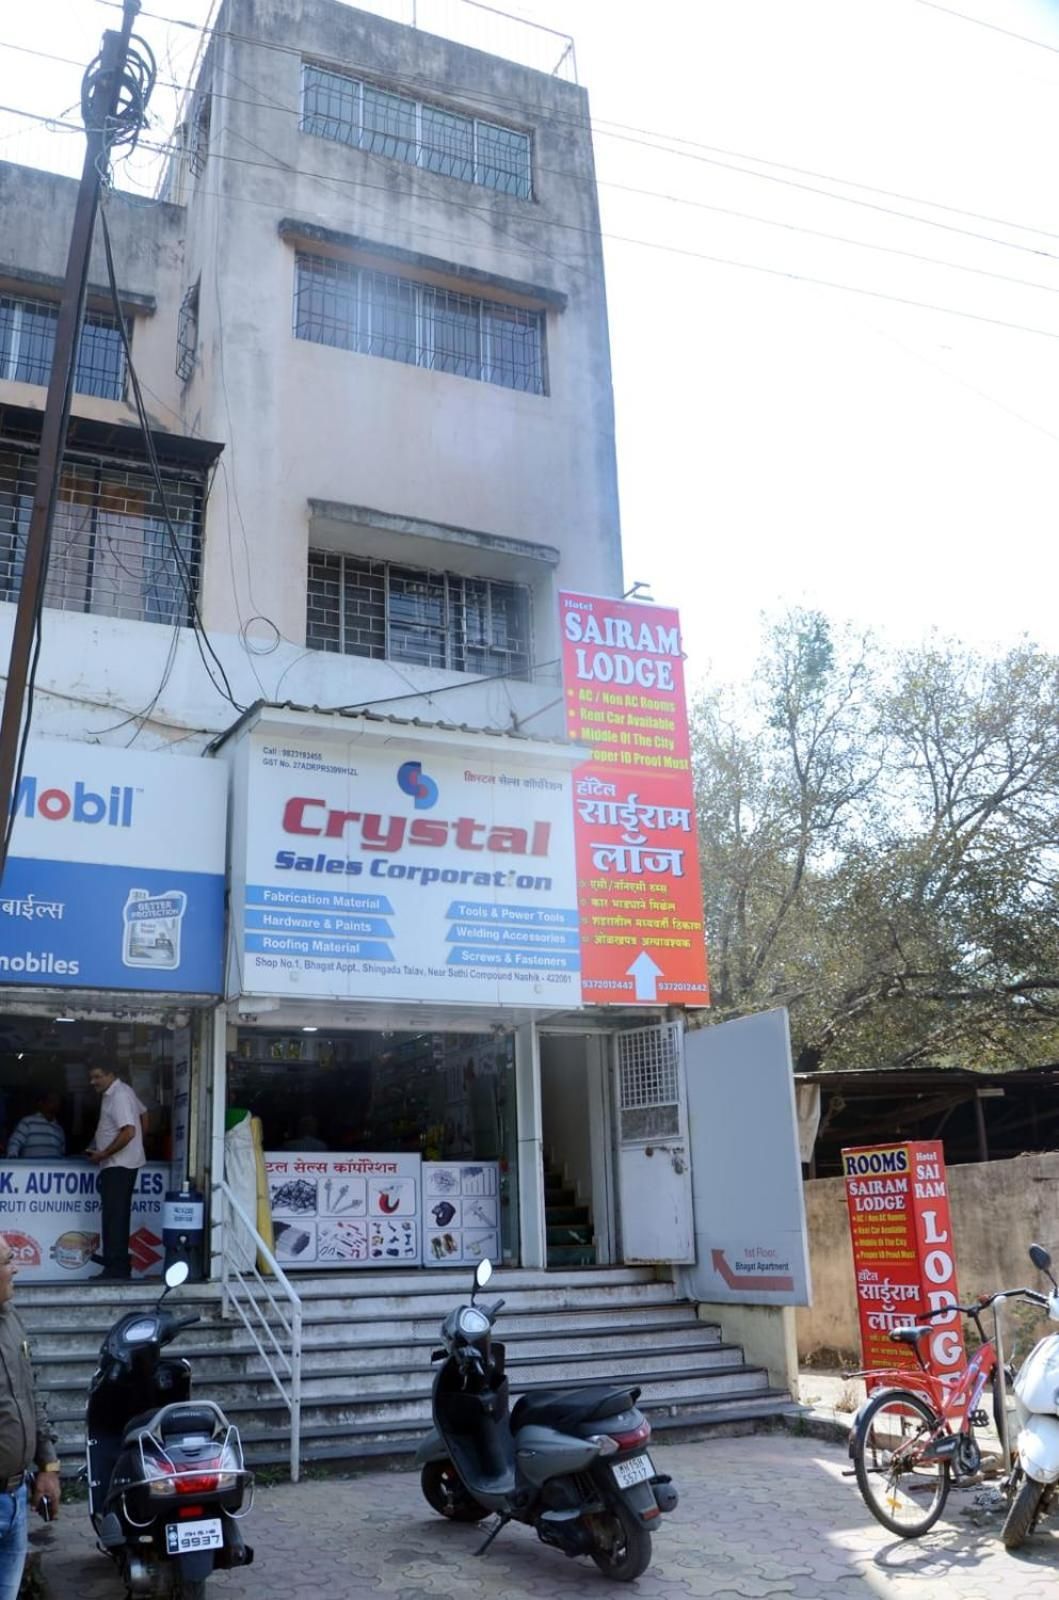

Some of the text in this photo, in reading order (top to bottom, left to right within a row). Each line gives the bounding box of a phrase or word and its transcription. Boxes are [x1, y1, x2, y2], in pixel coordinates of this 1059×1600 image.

[563, 599, 593, 611] Hotel
[565, 612, 681, 657] SAIRAM
[575, 649, 674, 691] LODGE
[607, 711, 625, 725] Car
[627, 714, 675, 731] Available
[263, 747, 277, 755] Call
[633, 733, 653, 747] The
[654, 735, 674, 751] City
[262, 758, 278, 766] GST
[280, 760, 291, 768] No.
[663, 755, 689, 769] Must
[576, 776, 616, 796] हॉटेल
[9, 776, 134, 827] Mobil
[577, 793, 691, 832] साईराम
[282, 797, 552, 857] Crystal
[590, 832, 684, 876] लॉज
[275, 851, 363, 876] Sales
[263, 891, 380, 909] Fabrication Material
[263, 914, 372, 932] Hardware & Paints
[458, 905, 565, 923] Tools & Power Tools
[456, 926, 566, 944] Welding Accessories
[263, 938, 360, 954] Roofing Material
[462, 950, 567, 967] Screws & Fasteners
[255, 957, 279, 969] Shop
[304, 960, 334, 973] Bhagat
[362, 964, 401, 976] Shingada
[428, 967, 446, 977] Near
[470, 970, 512, 982] Compound
[514, 972, 540, 982] Nashik
[293, 1158, 328, 1173] सेल्स
[845, 1151, 907, 1175] ROOMS
[915, 1152, 937, 1162] Hotel
[916, 1164, 940, 1180] SAI
[25, 1171, 163, 1195] AUTOMES
[849, 1178, 908, 1196] SAIRAM
[914, 1182, 946, 1198] RAM
[29, 1200, 82, 1213] GUNUINE
[131, 1200, 161, 1213] ARTS
[855, 1195, 905, 1211] LODGE
[744, 1247, 755, 1258] 1st
[735, 1261, 789, 1272] Bhagat Apartment
[859, 1278, 920, 1303] साईराम
[181, 1535, 220, 1548] 9937
